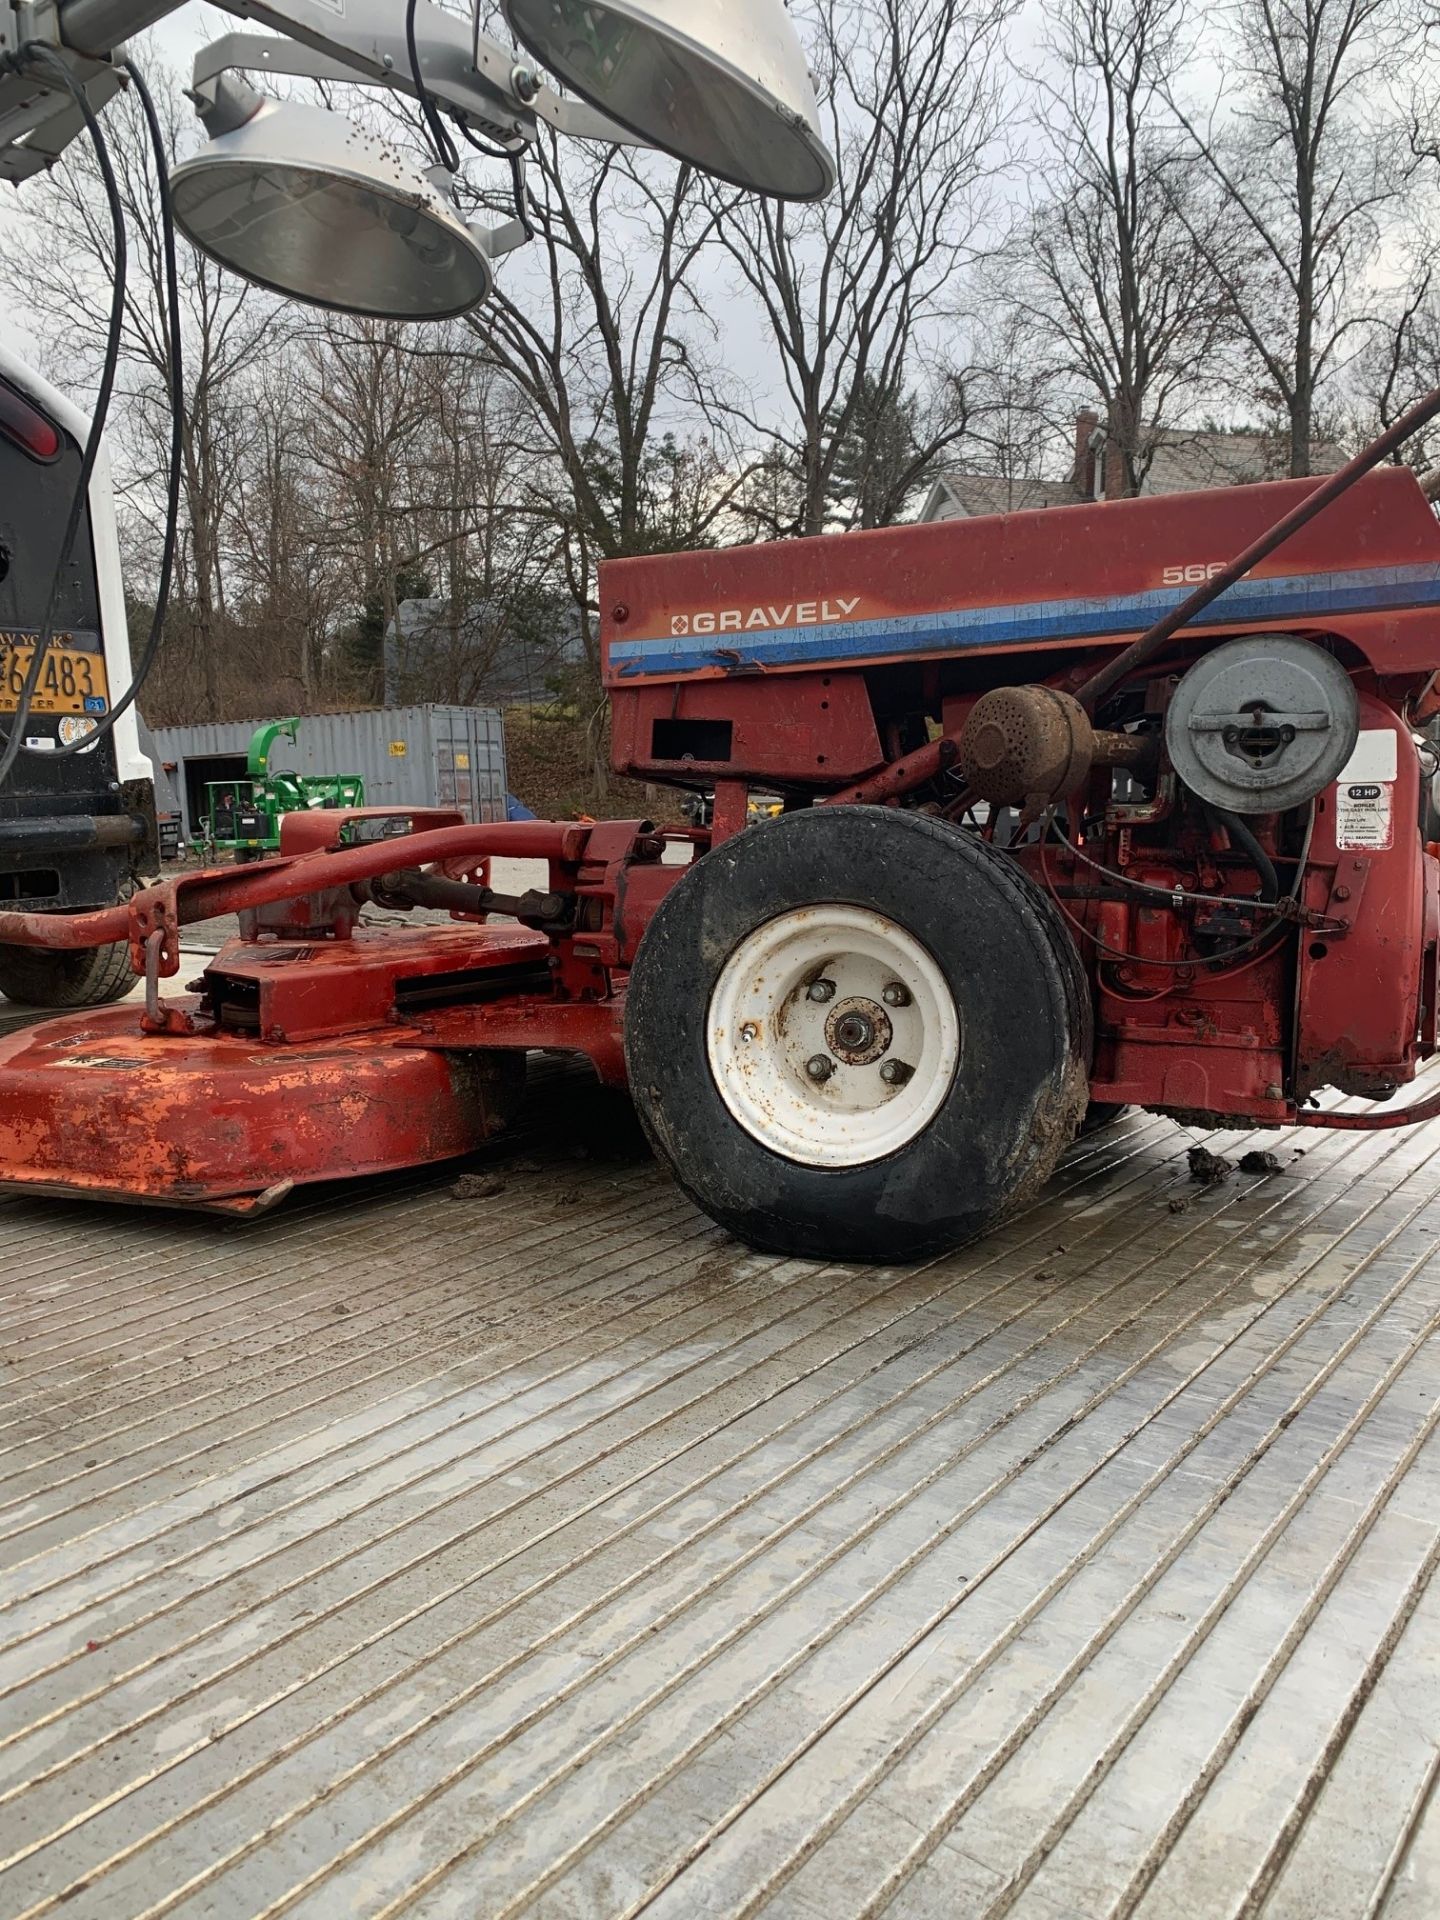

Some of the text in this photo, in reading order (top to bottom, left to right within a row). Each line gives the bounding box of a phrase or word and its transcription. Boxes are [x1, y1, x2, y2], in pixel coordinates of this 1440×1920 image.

[1163, 561, 1251, 585] 566
[693, 597, 861, 633] GRAVELY
[20, 634, 63, 648] YOK
